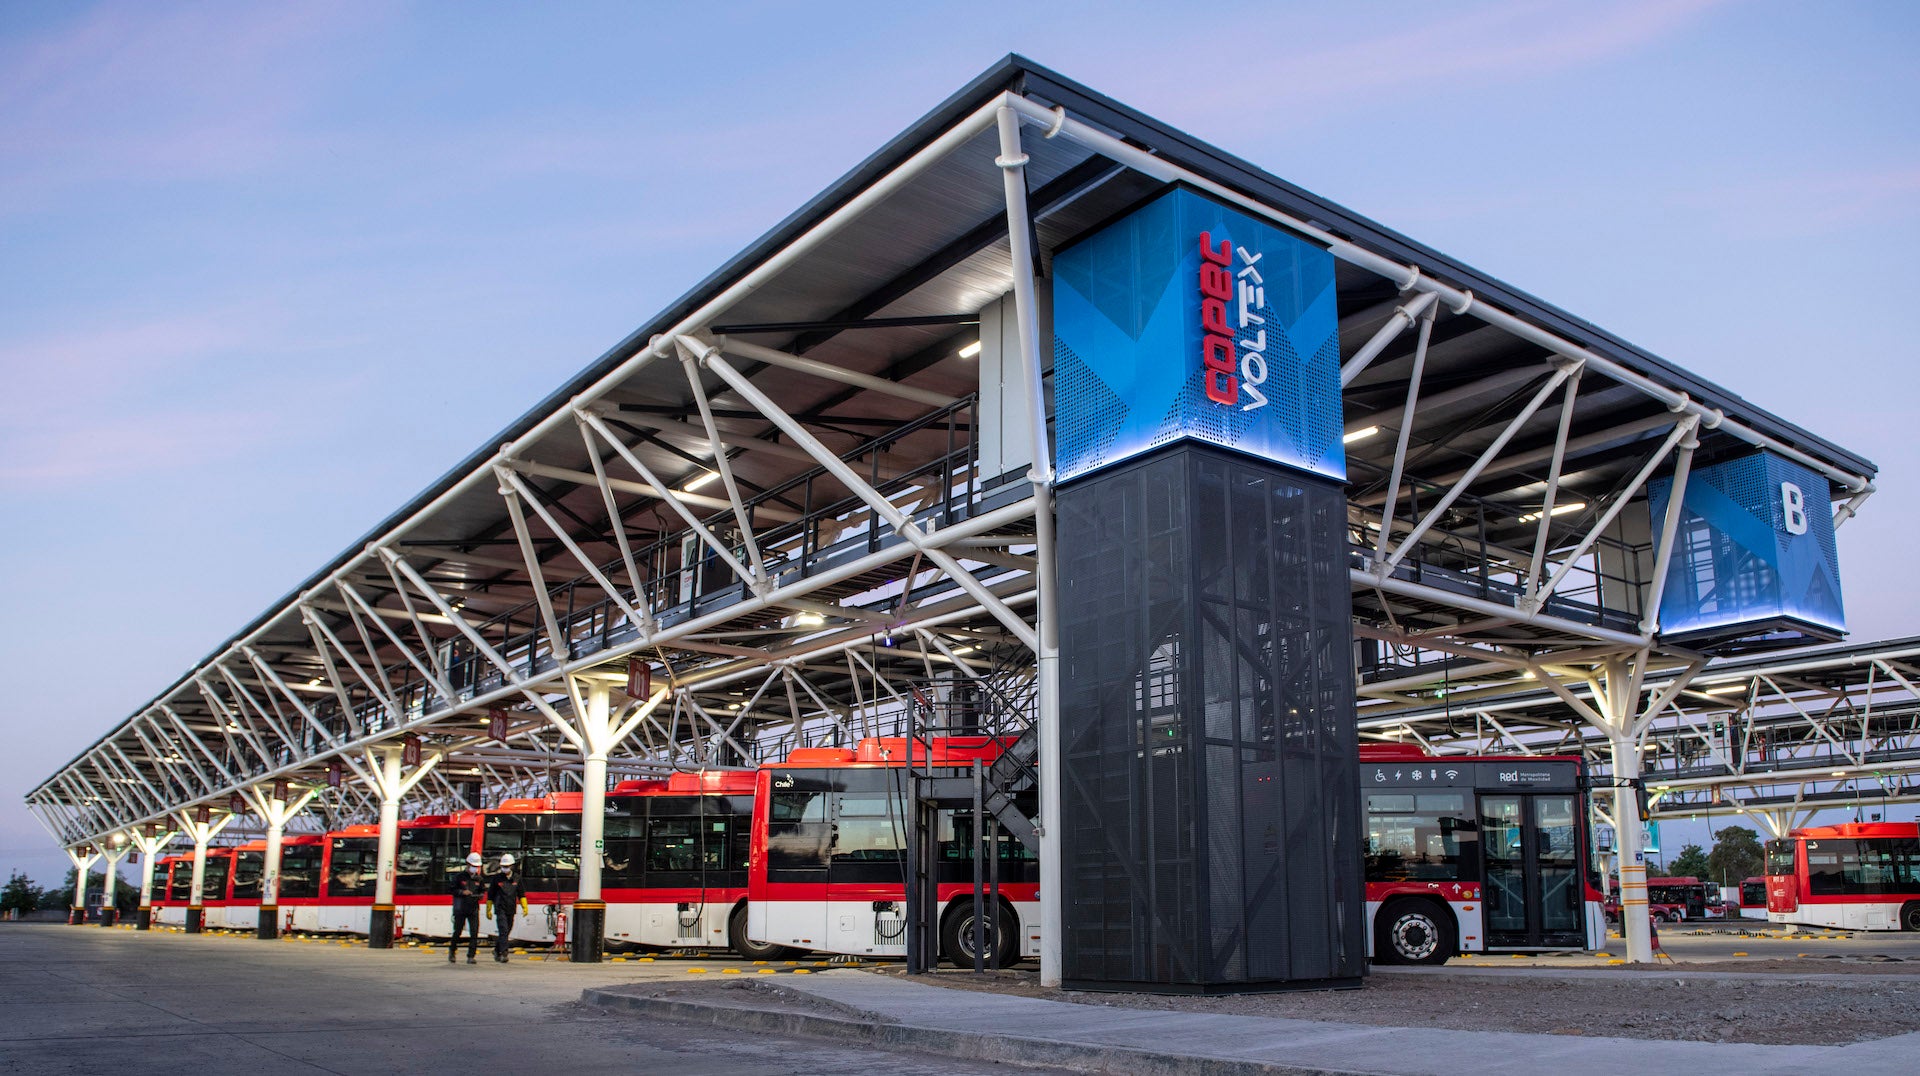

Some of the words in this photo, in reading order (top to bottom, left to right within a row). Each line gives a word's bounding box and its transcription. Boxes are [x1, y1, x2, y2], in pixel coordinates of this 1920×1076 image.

[1200, 231, 1238, 405] COPEC
[1237, 246, 1268, 411] VOLTEX
[1781, 482, 1807, 535] B
[633, 670, 645, 698] 01
[492, 716, 505, 739] 02
[1500, 770, 1518, 782] Red
